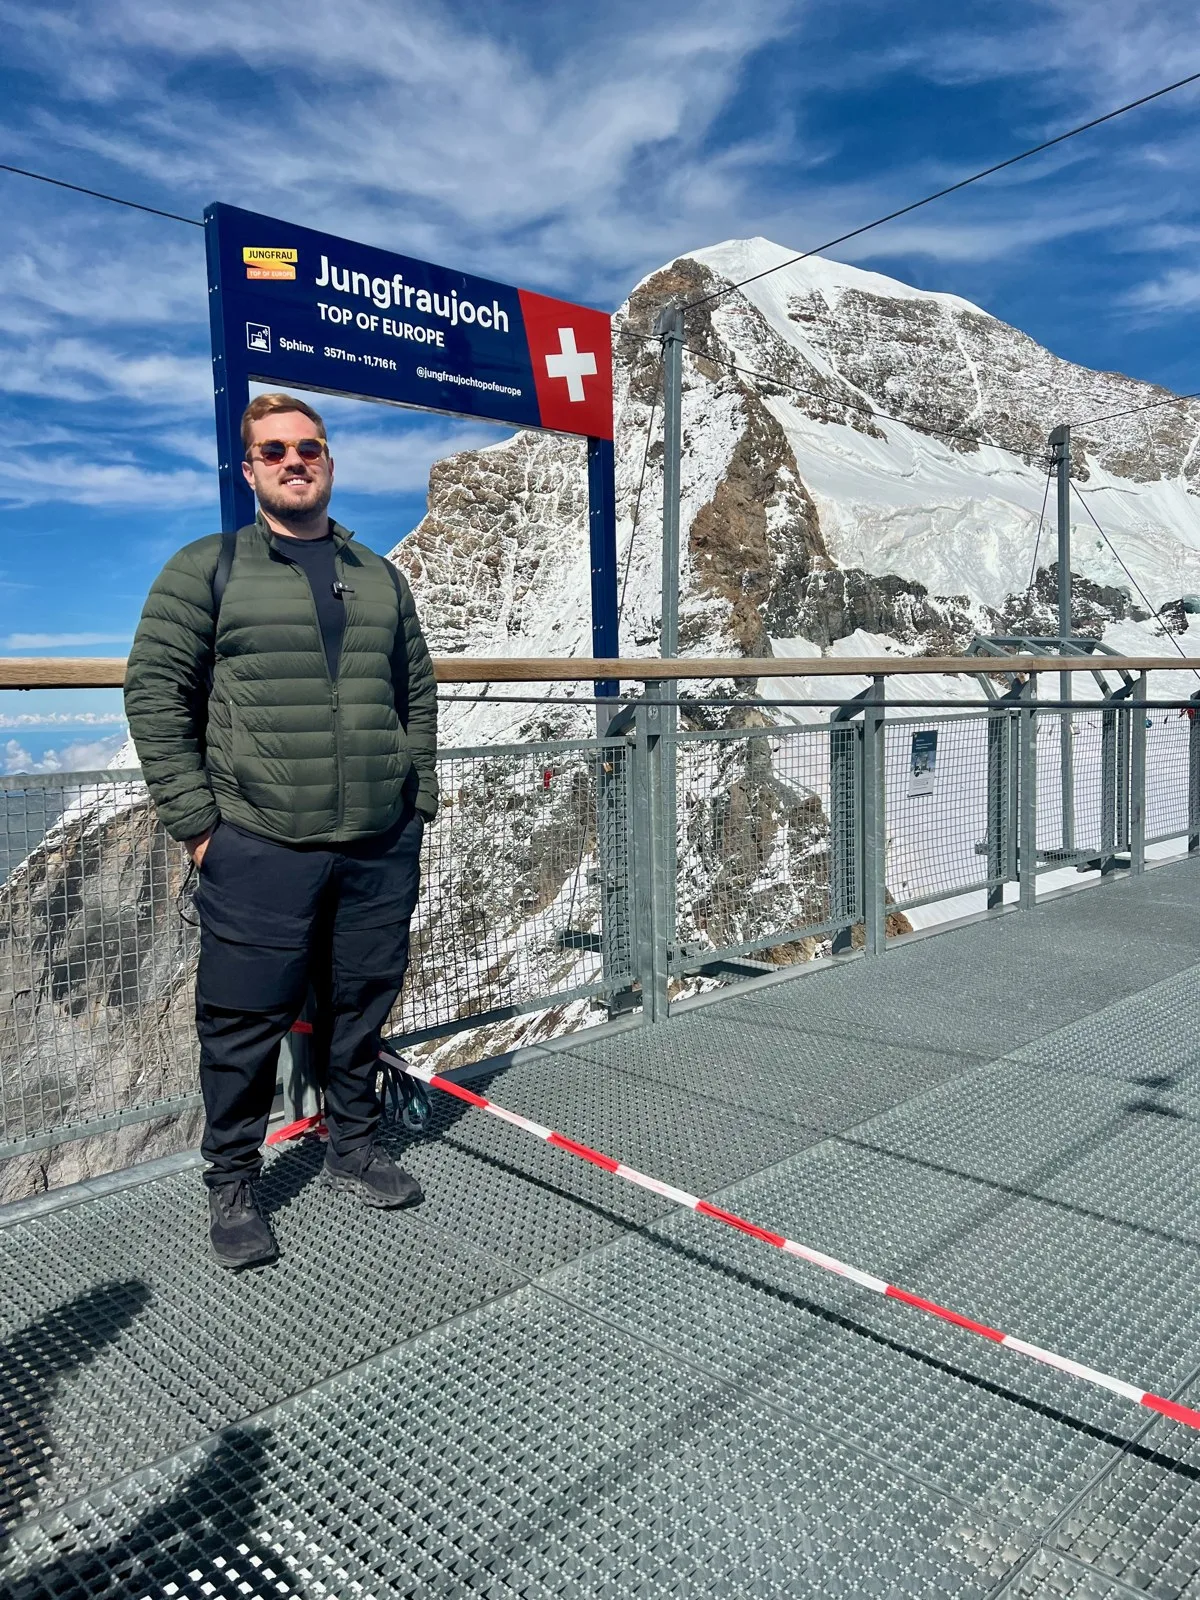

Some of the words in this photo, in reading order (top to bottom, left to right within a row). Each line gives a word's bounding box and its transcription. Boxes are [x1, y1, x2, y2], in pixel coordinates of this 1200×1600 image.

[248, 250, 293, 260] JUNGFRAU
[315, 254, 509, 333] Jungfraujoch
[317, 302, 352, 325] TOP
[356, 312, 379, 332] OF
[382, 317, 445, 347] EUROPE
[279, 337, 314, 354] Sphinx
[416, 366, 522, 396] @jungfraujochtopofeurope
